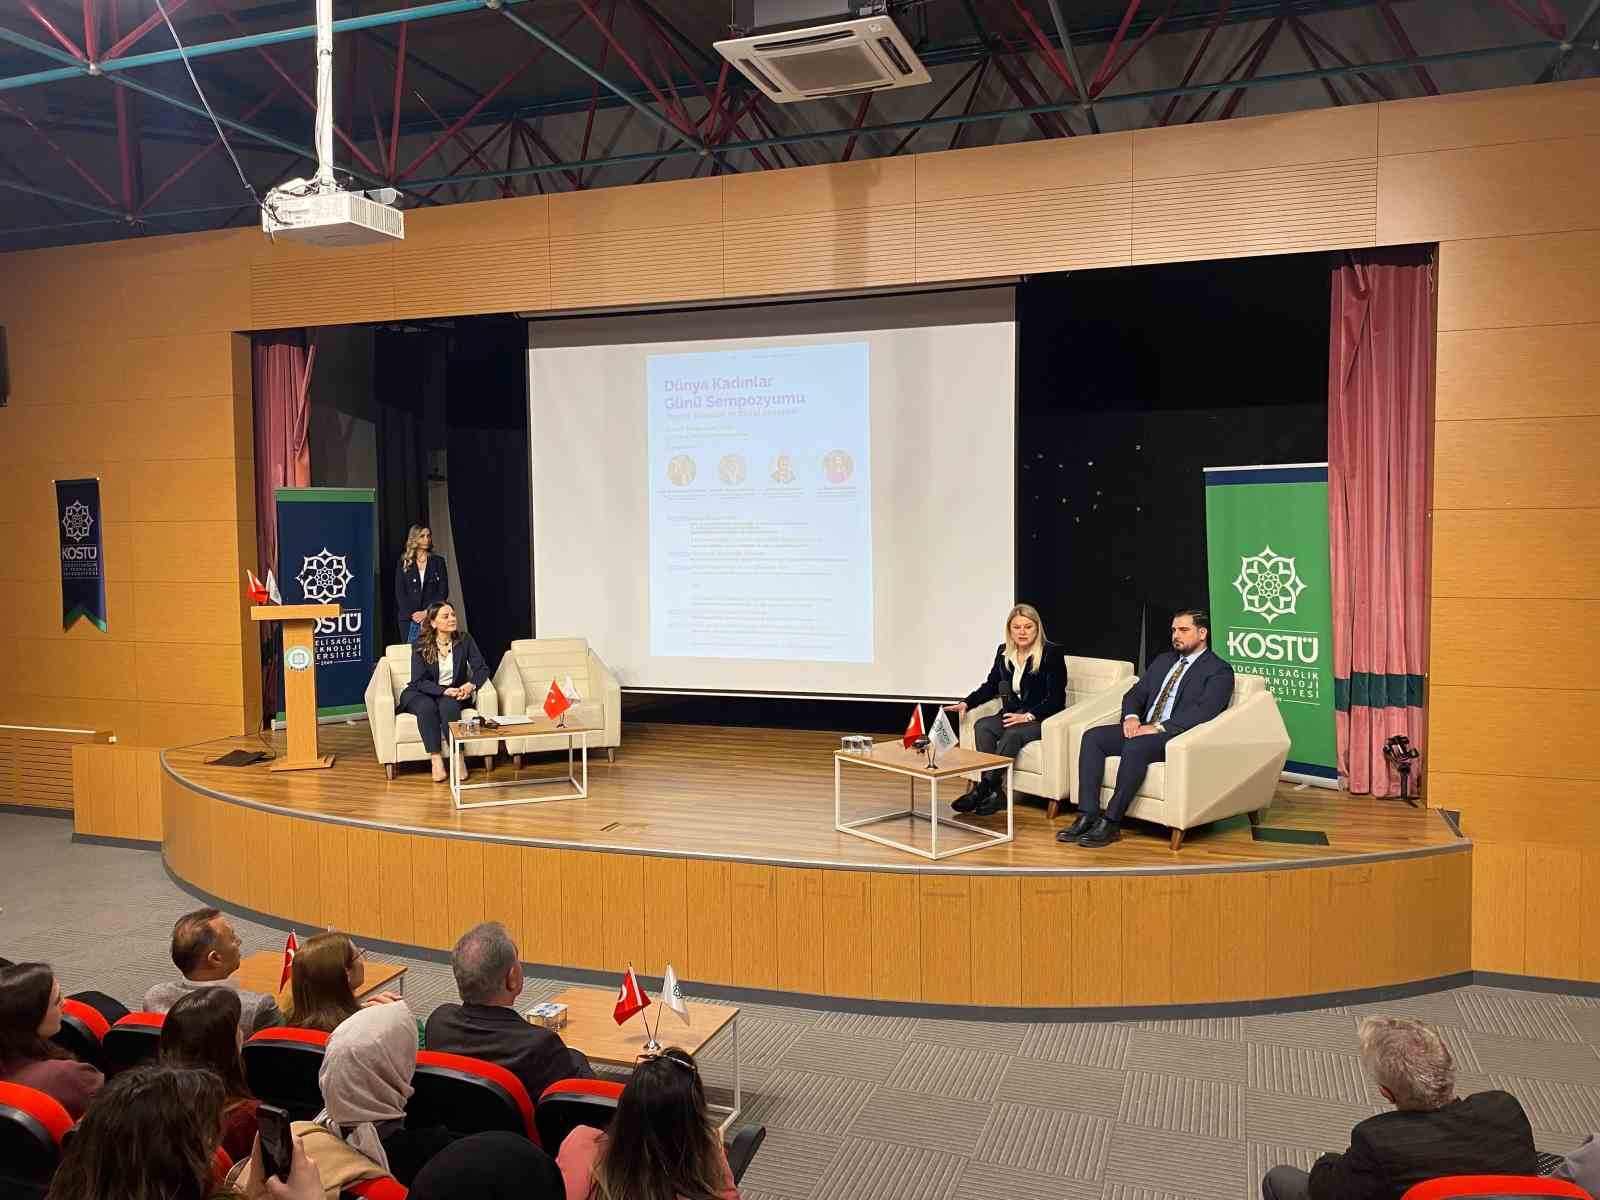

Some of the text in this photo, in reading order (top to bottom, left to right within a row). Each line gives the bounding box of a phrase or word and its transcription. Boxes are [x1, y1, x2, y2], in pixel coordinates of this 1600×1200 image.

[664, 376, 776, 394] Dünya Kadınlar
[664, 392, 807, 409] Günü Sempozyumu
[1227, 631, 1319, 664] KOSTÜ
[1265, 677, 1319, 689] KNOLOJİ
[1279, 669, 1319, 680] SAĞLIK
